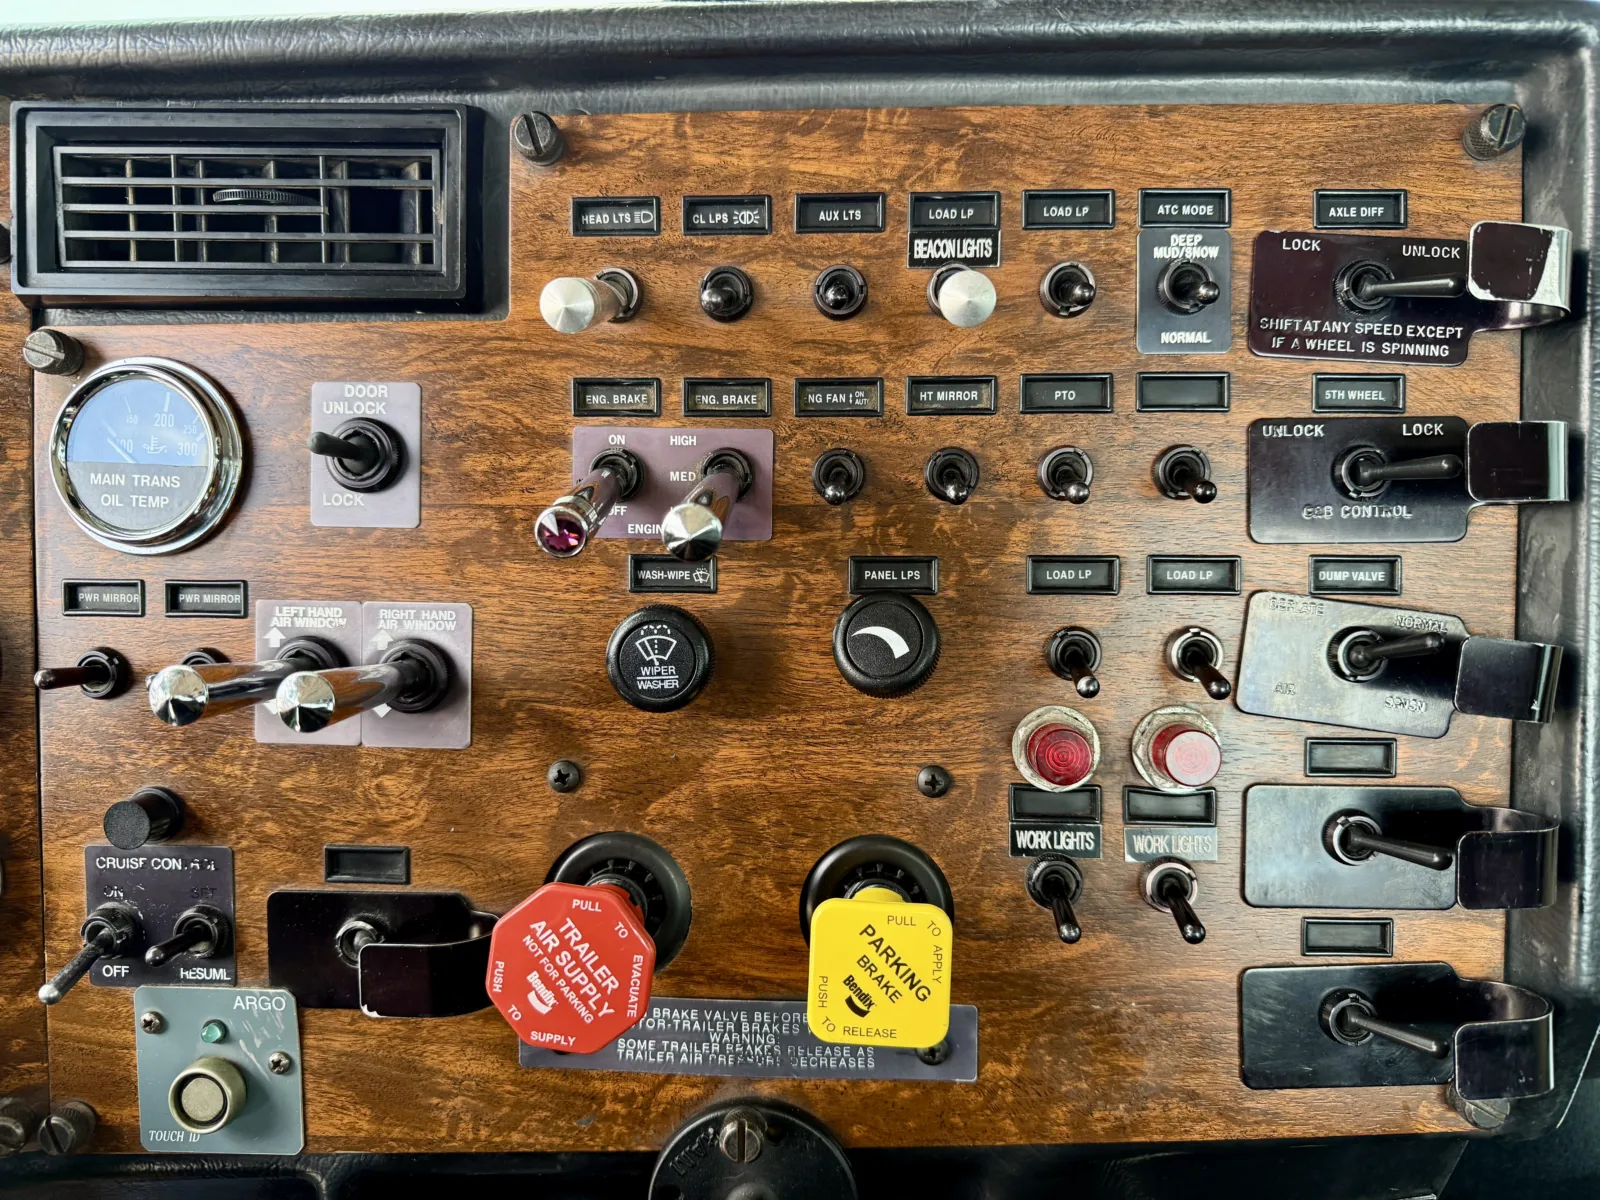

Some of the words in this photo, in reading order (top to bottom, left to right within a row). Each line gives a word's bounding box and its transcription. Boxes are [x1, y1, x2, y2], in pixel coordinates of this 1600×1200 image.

[819, 210, 840, 221] AUX
[843, 210, 862, 221] LTS
[929, 208, 957, 219] LOAD
[961, 208, 974, 219] LP
[1043, 206, 1072, 217] LOAD
[1076, 206, 1089, 217] LP
[1157, 205, 1179, 215] ATC
[1182, 205, 1214, 215] MODE
[1329, 207, 1357, 217] AXLE
[1360, 207, 1384, 217] DIFF
[582, 214, 610, 225] HEAD
[613, 213, 631, 224] LTS
[692, 213, 706, 224] CL
[709, 213, 729, 224] LPS
[1171, 233, 1203, 247] DEEP
[1282, 238, 1321, 252] LOCK
[914, 239, 956, 260] BEACON
[957, 239, 992, 259] LIGHTS
[1153, 246, 1220, 259] MUD/SNOW
[1402, 244, 1461, 260] UNLOCK
[1260, 317, 1303, 332] SHIFT
[1303, 319, 1321, 333] AT
[1322, 320, 1350, 334] ANY
[1354, 322, 1402, 336] SPEED
[1406, 325, 1463, 339] EXCEPT
[1161, 331, 1212, 344] NORMAL
[1271, 336, 1286, 349] IF
[1291, 337, 1300, 349] A
[1305, 338, 1355, 352] WHEEL
[1361, 341, 1375, 353] IS
[1382, 342, 1450, 357] SPINNING
[344, 384, 388, 398] DOOR
[920, 391, 934, 401] HT
[937, 390, 978, 401] MIRROR
[1054, 390, 1076, 400] PTO
[1325, 390, 1346, 400] 5TH
[1348, 390, 1385, 401] WHEEL
[613, 394, 648, 404] BRAKE
[723, 394, 757, 404] BRAKE
[804, 393, 822, 403] NG
[826, 393, 846, 403] FAN
[323, 401, 387, 415] UNLOCK
[153, 413, 175, 428] 200
[183, 424, 197, 434] 250
[1262, 424, 1325, 437] UNLOCK
[1402, 423, 1444, 436] LOCK
[608, 435, 626, 446] ON
[670, 435, 697, 447] HIGH
[177, 442, 198, 456] 300
[90, 473, 125, 486] MAIN
[132, 474, 181, 488] TRANS
[669, 471, 696, 482] MED
[101, 494, 124, 507] OIL
[129, 495, 169, 508] TEMP
[322, 493, 365, 507] LOCK
[1340, 505, 1413, 519] CONTROL
[628, 523, 664, 534] ENGIN
[637, 569, 691, 581] WASH-WIPE
[864, 570, 898, 581] PANEL
[901, 570, 920, 581] LPS
[1046, 570, 1075, 580] LOAD
[1078, 569, 1092, 580] LP
[1166, 570, 1196, 581] LOAD
[1199, 570, 1213, 581] LP
[1319, 571, 1350, 582] DUMP
[1351, 571, 1385, 582] VALVE
[79, 593, 99, 602] PWR
[103, 593, 139, 603] MIRROR
[179, 593, 200, 603] PWR
[203, 594, 241, 604] MIRROR
[275, 606, 304, 617] LEFT
[307, 607, 343, 618] HAND
[379, 609, 416, 620] RIGHT
[422, 610, 456, 621] HAND
[269, 617, 292, 628] AIR
[377, 620, 398, 631] AIR
[403, 620, 457, 631] WINDOW
[1394, 615, 1448, 633] NORMAL
[640, 666, 676, 677] WIPER
[637, 680, 679, 690] WASHER
[1274, 682, 1296, 695] AIR
[1015, 830, 1052, 850] WORK
[1053, 830, 1095, 850] LIGHTS
[1133, 834, 1169, 854] WORK
[1171, 834, 1212, 854] LIGHTS
[572, 899, 602, 912] PULL
[887, 915, 917, 927] PULL
[613, 921, 629, 939] TO
[927, 920, 942, 937] TO
[558, 918, 620, 995] TRAILER
[529, 920, 561, 953] AIR
[555, 951, 616, 1018] SUPPLY
[859, 924, 932, 1003] PARKING
[931, 944, 943, 985] APPLY
[102, 965, 130, 977] OFF
[492, 960, 505, 993] PUSH
[522, 934, 543, 959] NOT
[538, 957, 562, 981] FOR
[556, 977, 594, 1024] PARKING
[856, 954, 903, 1004] BRAKE
[526, 971, 559, 1007] Bendix
[626, 954, 644, 1018] EVACUATE
[818, 975, 829, 1009] PUSH
[843, 974, 876, 1011] Bendix
[233, 996, 286, 1011] ARGO
[507, 1004, 522, 1021] TO
[653, 1008, 699, 1020] BRAKE
[704, 1010, 748, 1022] VALVE
[632, 1018, 735, 1032] TOR-TRAILER
[741, 1023, 800, 1034] BRAKES
[821, 1016, 836, 1033] TO
[530, 1030, 576, 1047] SUPPLY
[843, 1026, 897, 1039] RELEASE
[617, 1038, 656, 1051] SOME
[662, 1041, 720, 1054] TRAILER
[788, 1045, 851, 1057] RELEASE
[856, 1046, 874, 1057] AS
[617, 1050, 675, 1063] TRAILER
[680, 1053, 703, 1065] AIR
[149, 1130, 183, 1142] TOUCH
[189, 1131, 200, 1143] ID
